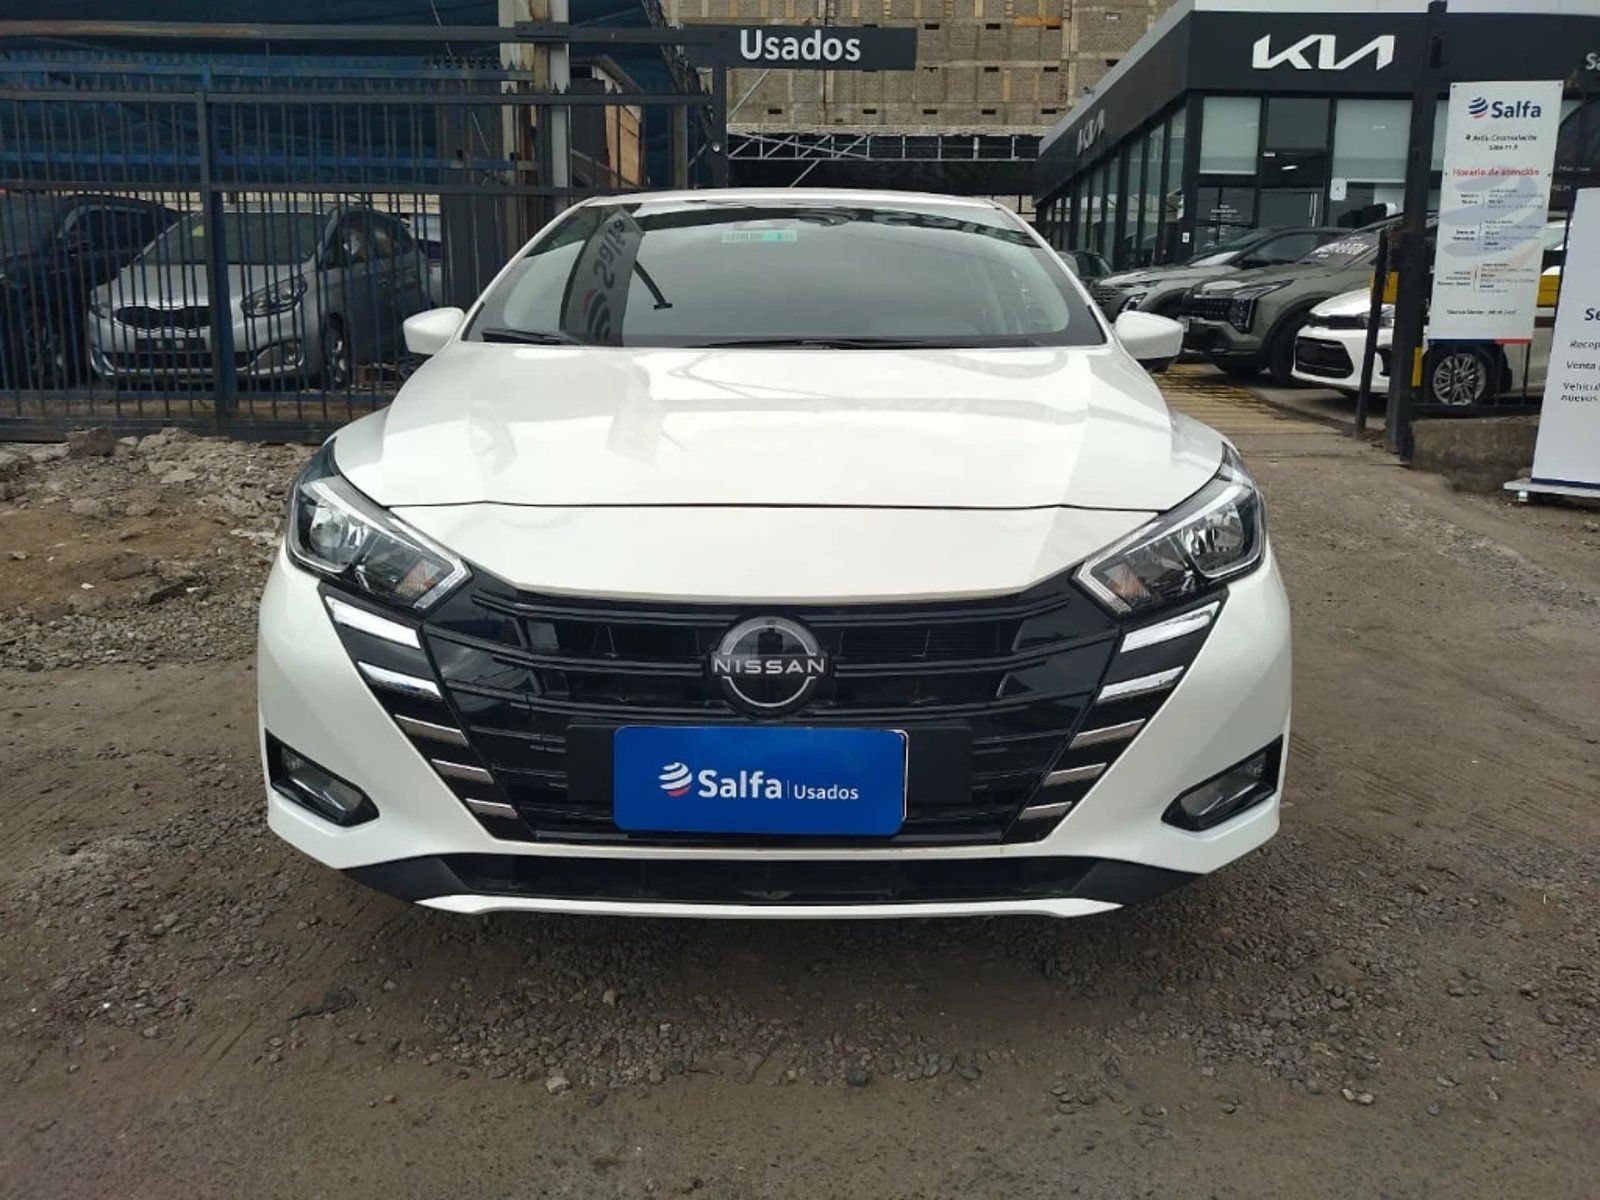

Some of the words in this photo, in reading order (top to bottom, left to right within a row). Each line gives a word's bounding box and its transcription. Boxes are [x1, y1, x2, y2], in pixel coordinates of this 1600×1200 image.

[740, 29, 861, 62] Usados
[1252, 33, 1395, 71] KIA
[1491, 100, 1542, 119] Salfa
[1452, 168, 1486, 177] Horario
[1488, 168, 1500, 177] de
[1567, 361, 1596, 369] Venta
[714, 658, 824, 674] NISSAN
[698, 769, 783, 799] Salfa
[794, 785, 859, 800] Usados
